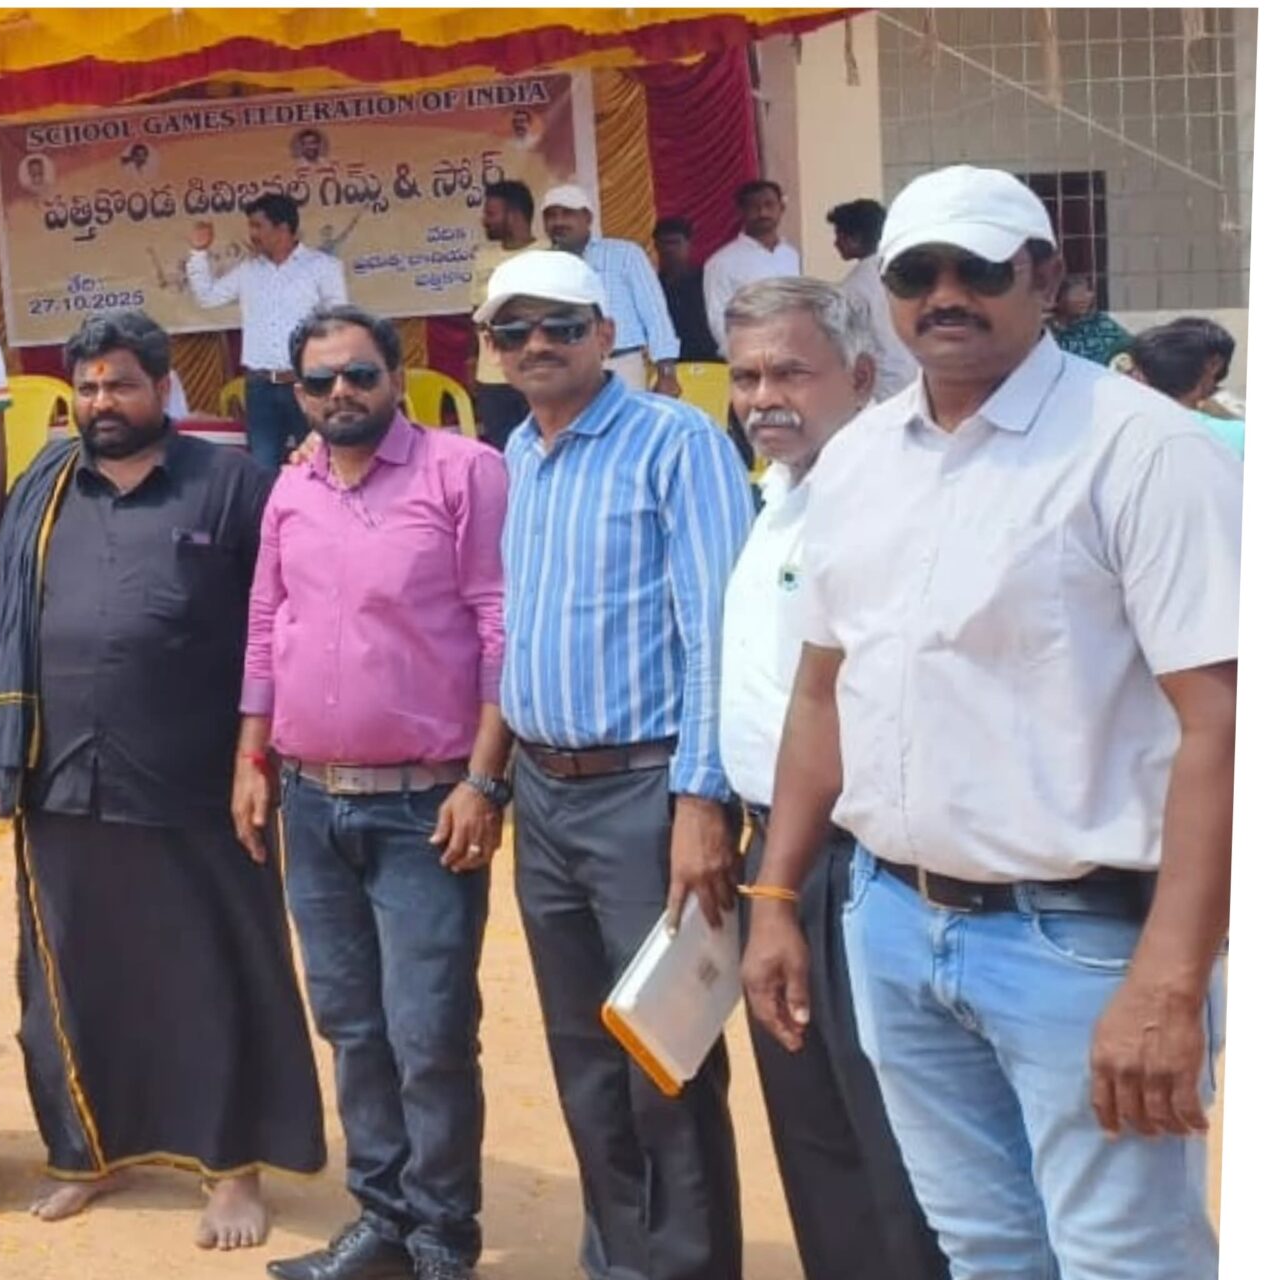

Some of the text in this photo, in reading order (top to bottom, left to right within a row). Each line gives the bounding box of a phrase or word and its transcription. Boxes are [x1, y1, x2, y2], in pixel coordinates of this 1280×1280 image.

[28, 82, 547, 147] SCHOOL GAMES FEDERATION OF INDIA
[44, 185, 177, 242] పత్తికొండ
[393, 163, 421, 200] &
[29, 290, 145, 315] 27.10.2025
